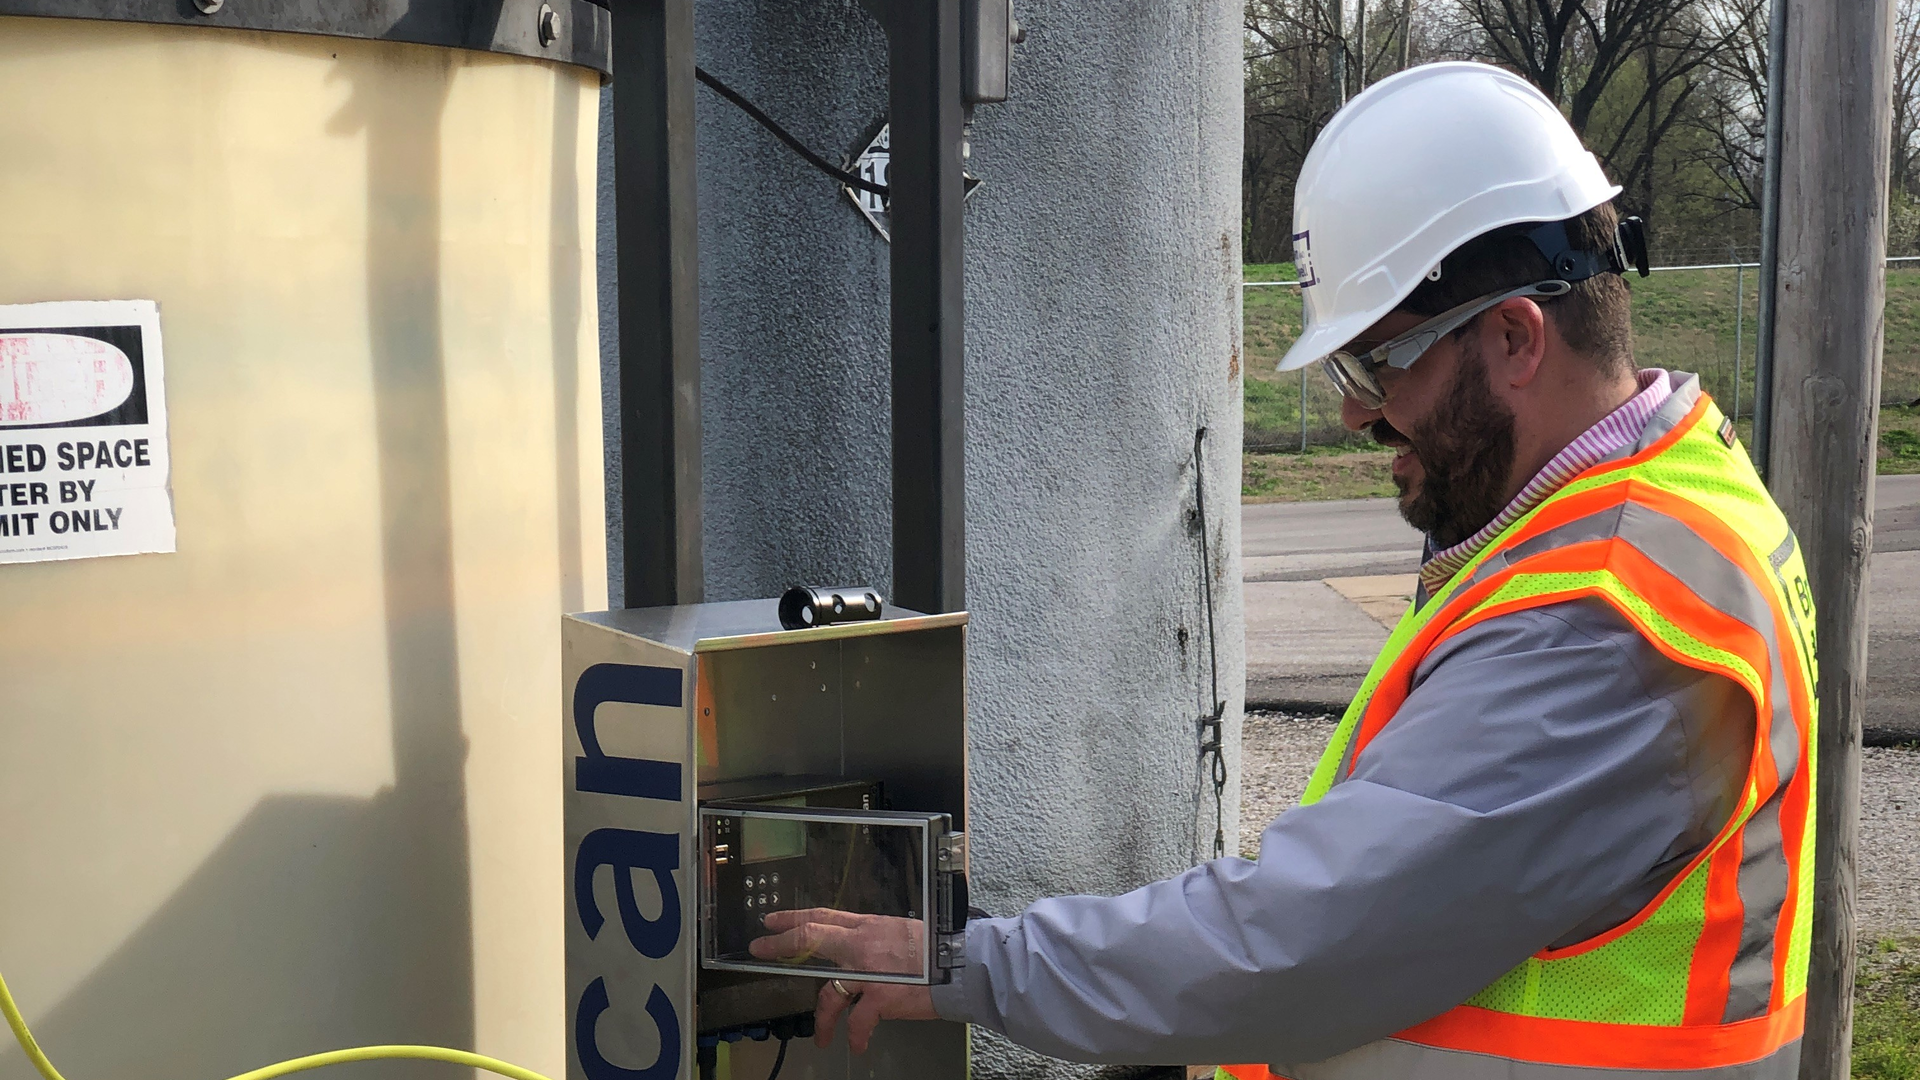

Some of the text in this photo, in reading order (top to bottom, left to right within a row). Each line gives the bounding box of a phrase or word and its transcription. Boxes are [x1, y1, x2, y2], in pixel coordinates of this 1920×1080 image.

[0, 438, 151, 473] ED SPACE
[59, 479, 96, 503] BY
[49, 507, 123, 535] ONLY
[573, 662, 683, 1080] can
